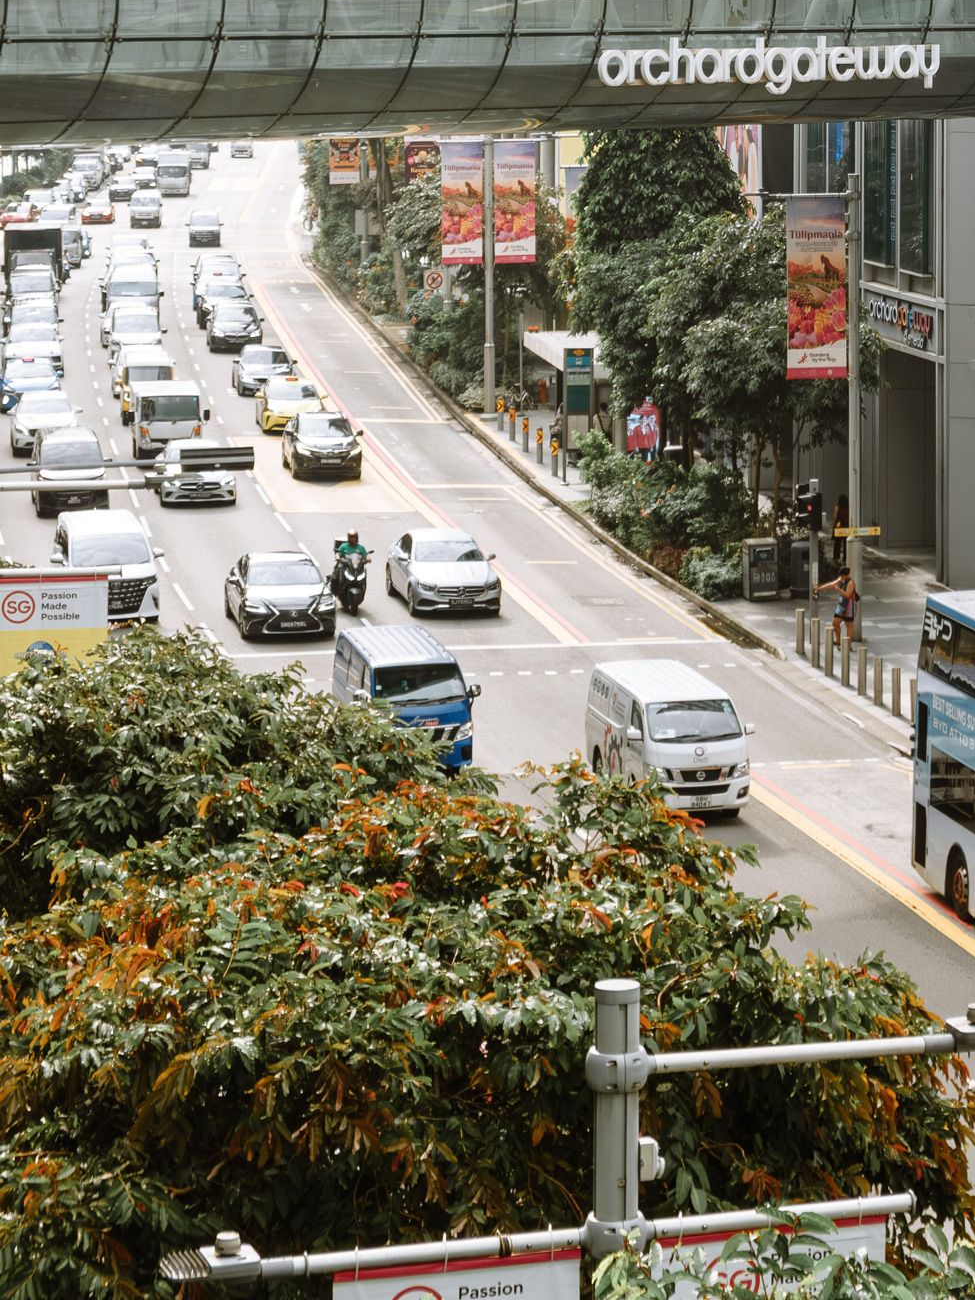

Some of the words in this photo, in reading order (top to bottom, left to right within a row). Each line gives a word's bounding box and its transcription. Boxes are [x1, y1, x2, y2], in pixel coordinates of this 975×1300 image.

[597, 35, 941, 95] orchardgateway
[41, 592, 78, 600] Passion
[6, 600, 31, 614] SG
[932, 694, 945, 714] BEST
[945, 701, 967, 727] SELLING
[458, 1282, 524, 1300] Passion
